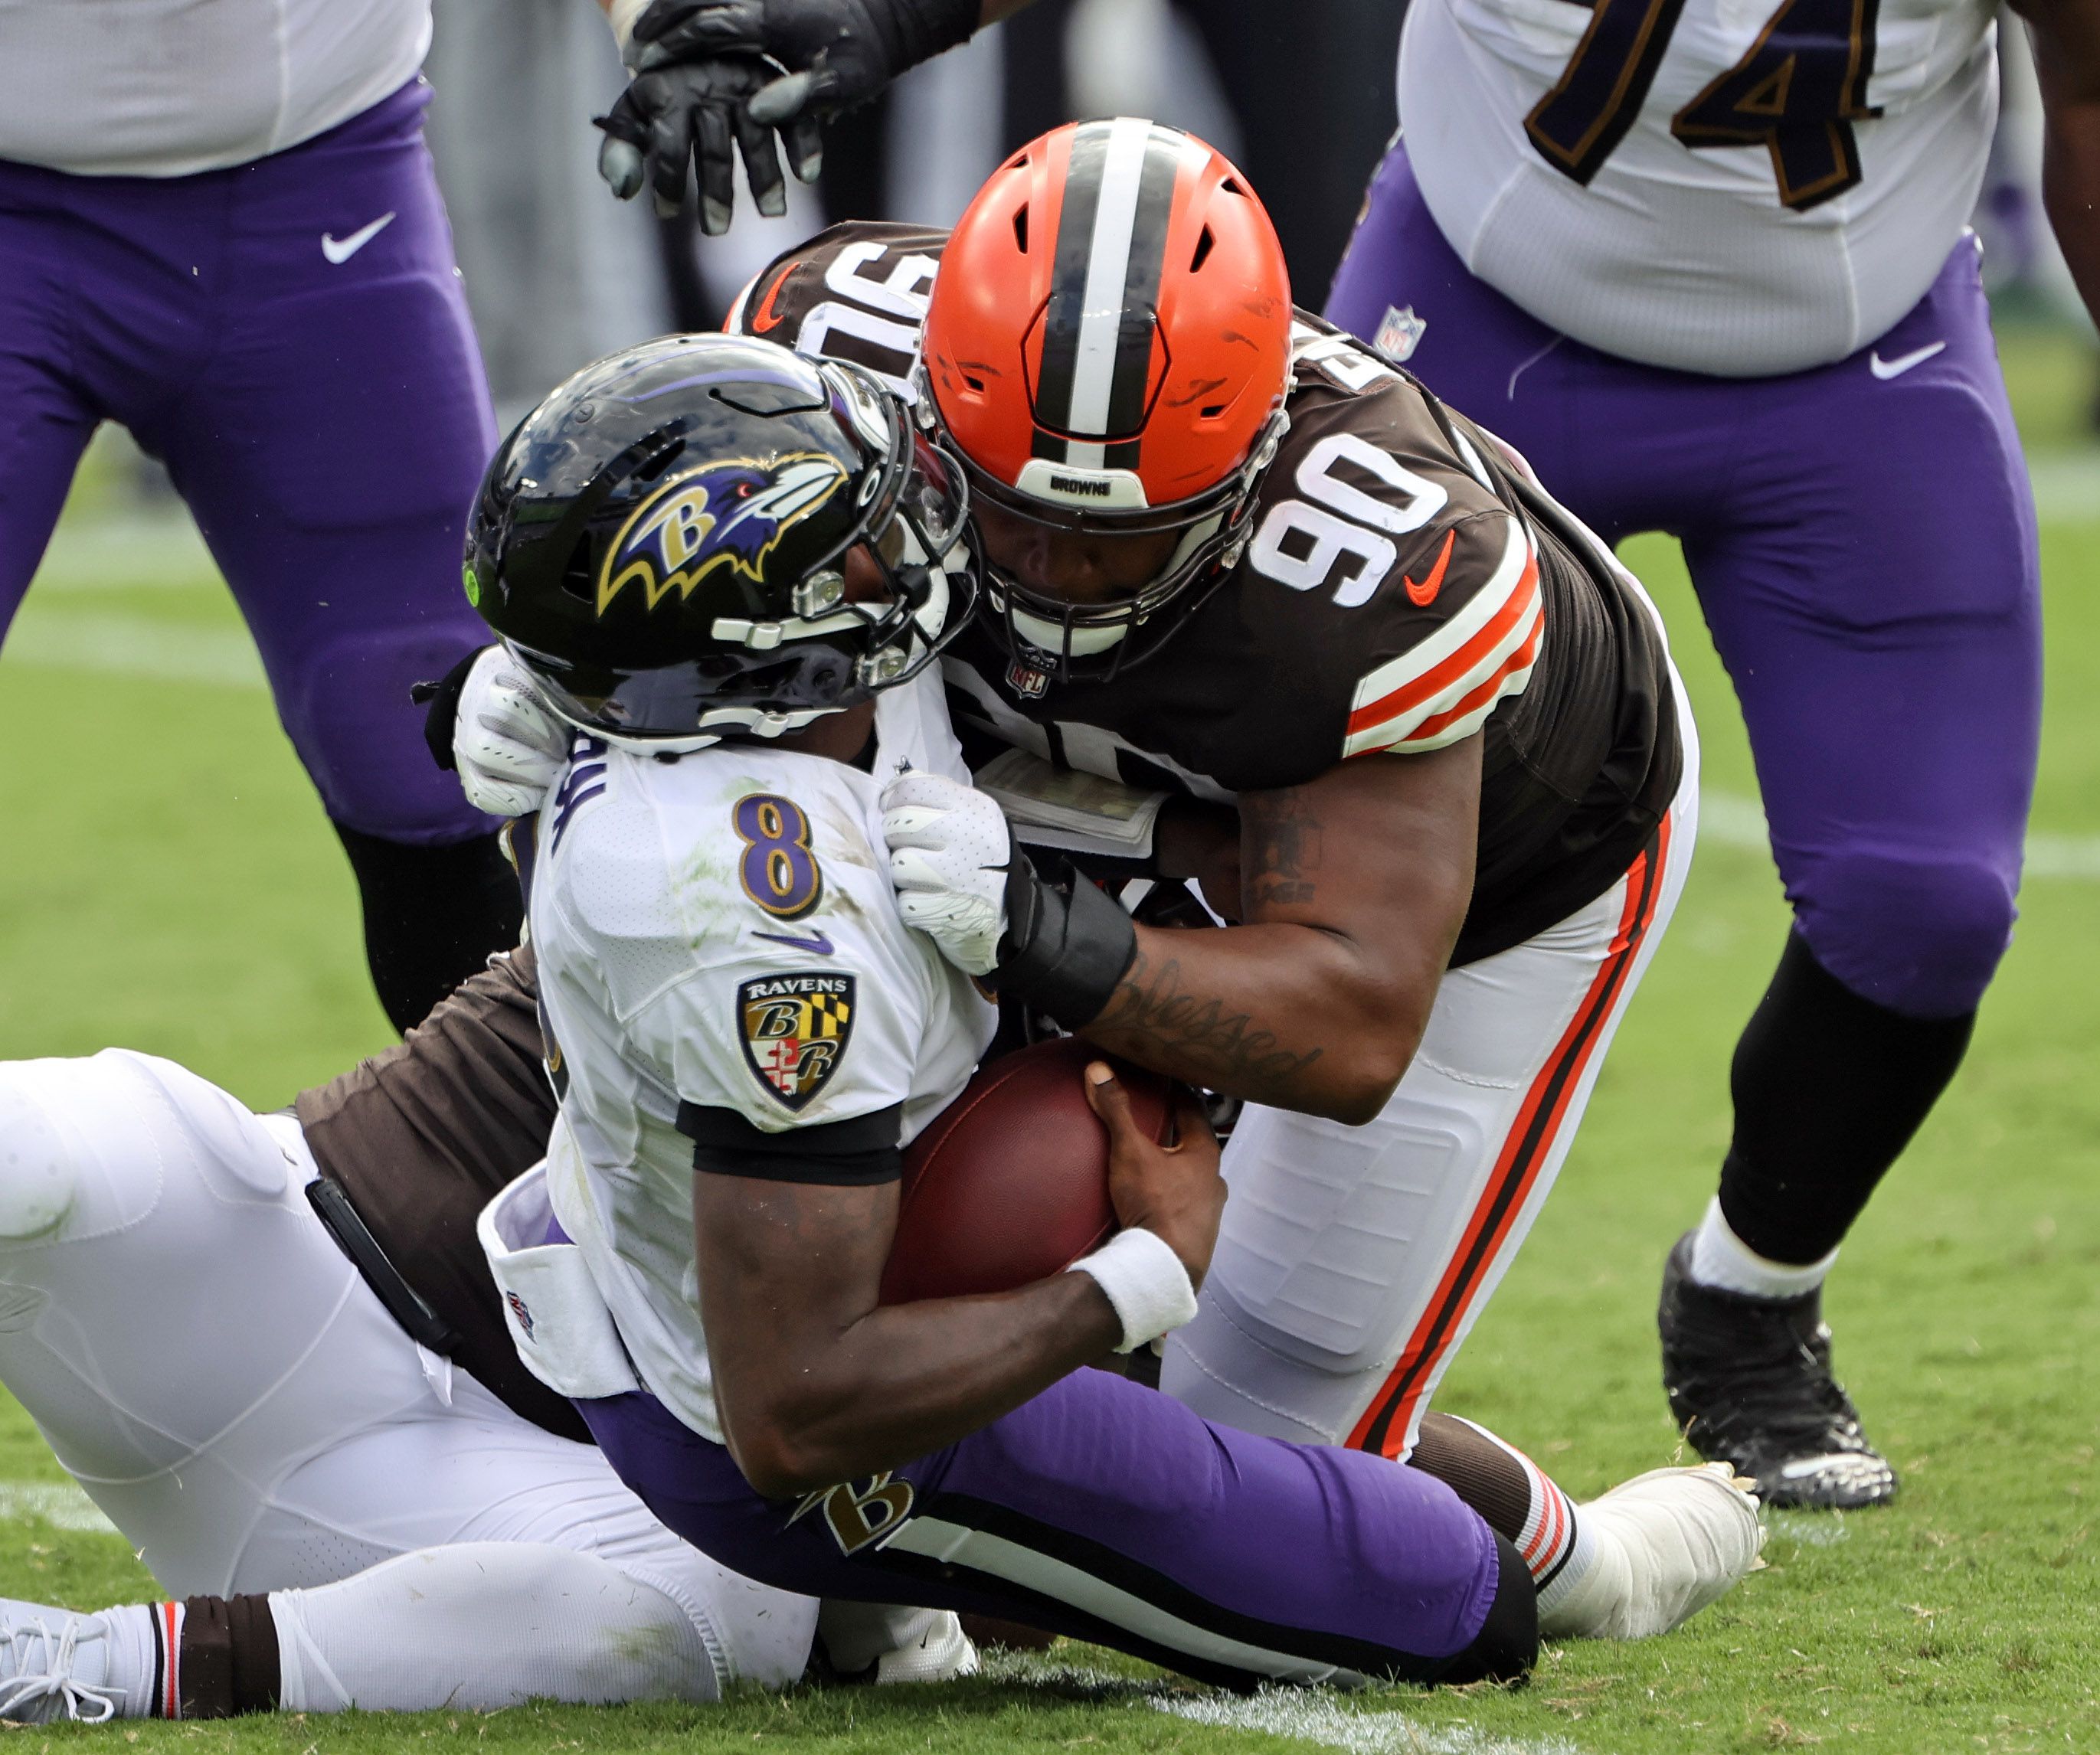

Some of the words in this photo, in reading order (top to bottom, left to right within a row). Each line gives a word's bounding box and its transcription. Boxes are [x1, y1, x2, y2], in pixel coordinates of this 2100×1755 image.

[1050, 475, 1111, 496] BROWNS
[1248, 432, 1448, 608] 90
[1012, 664, 1046, 693] NFL
[731, 793, 825, 920] 8
[746, 979, 848, 1000] RAVENS
